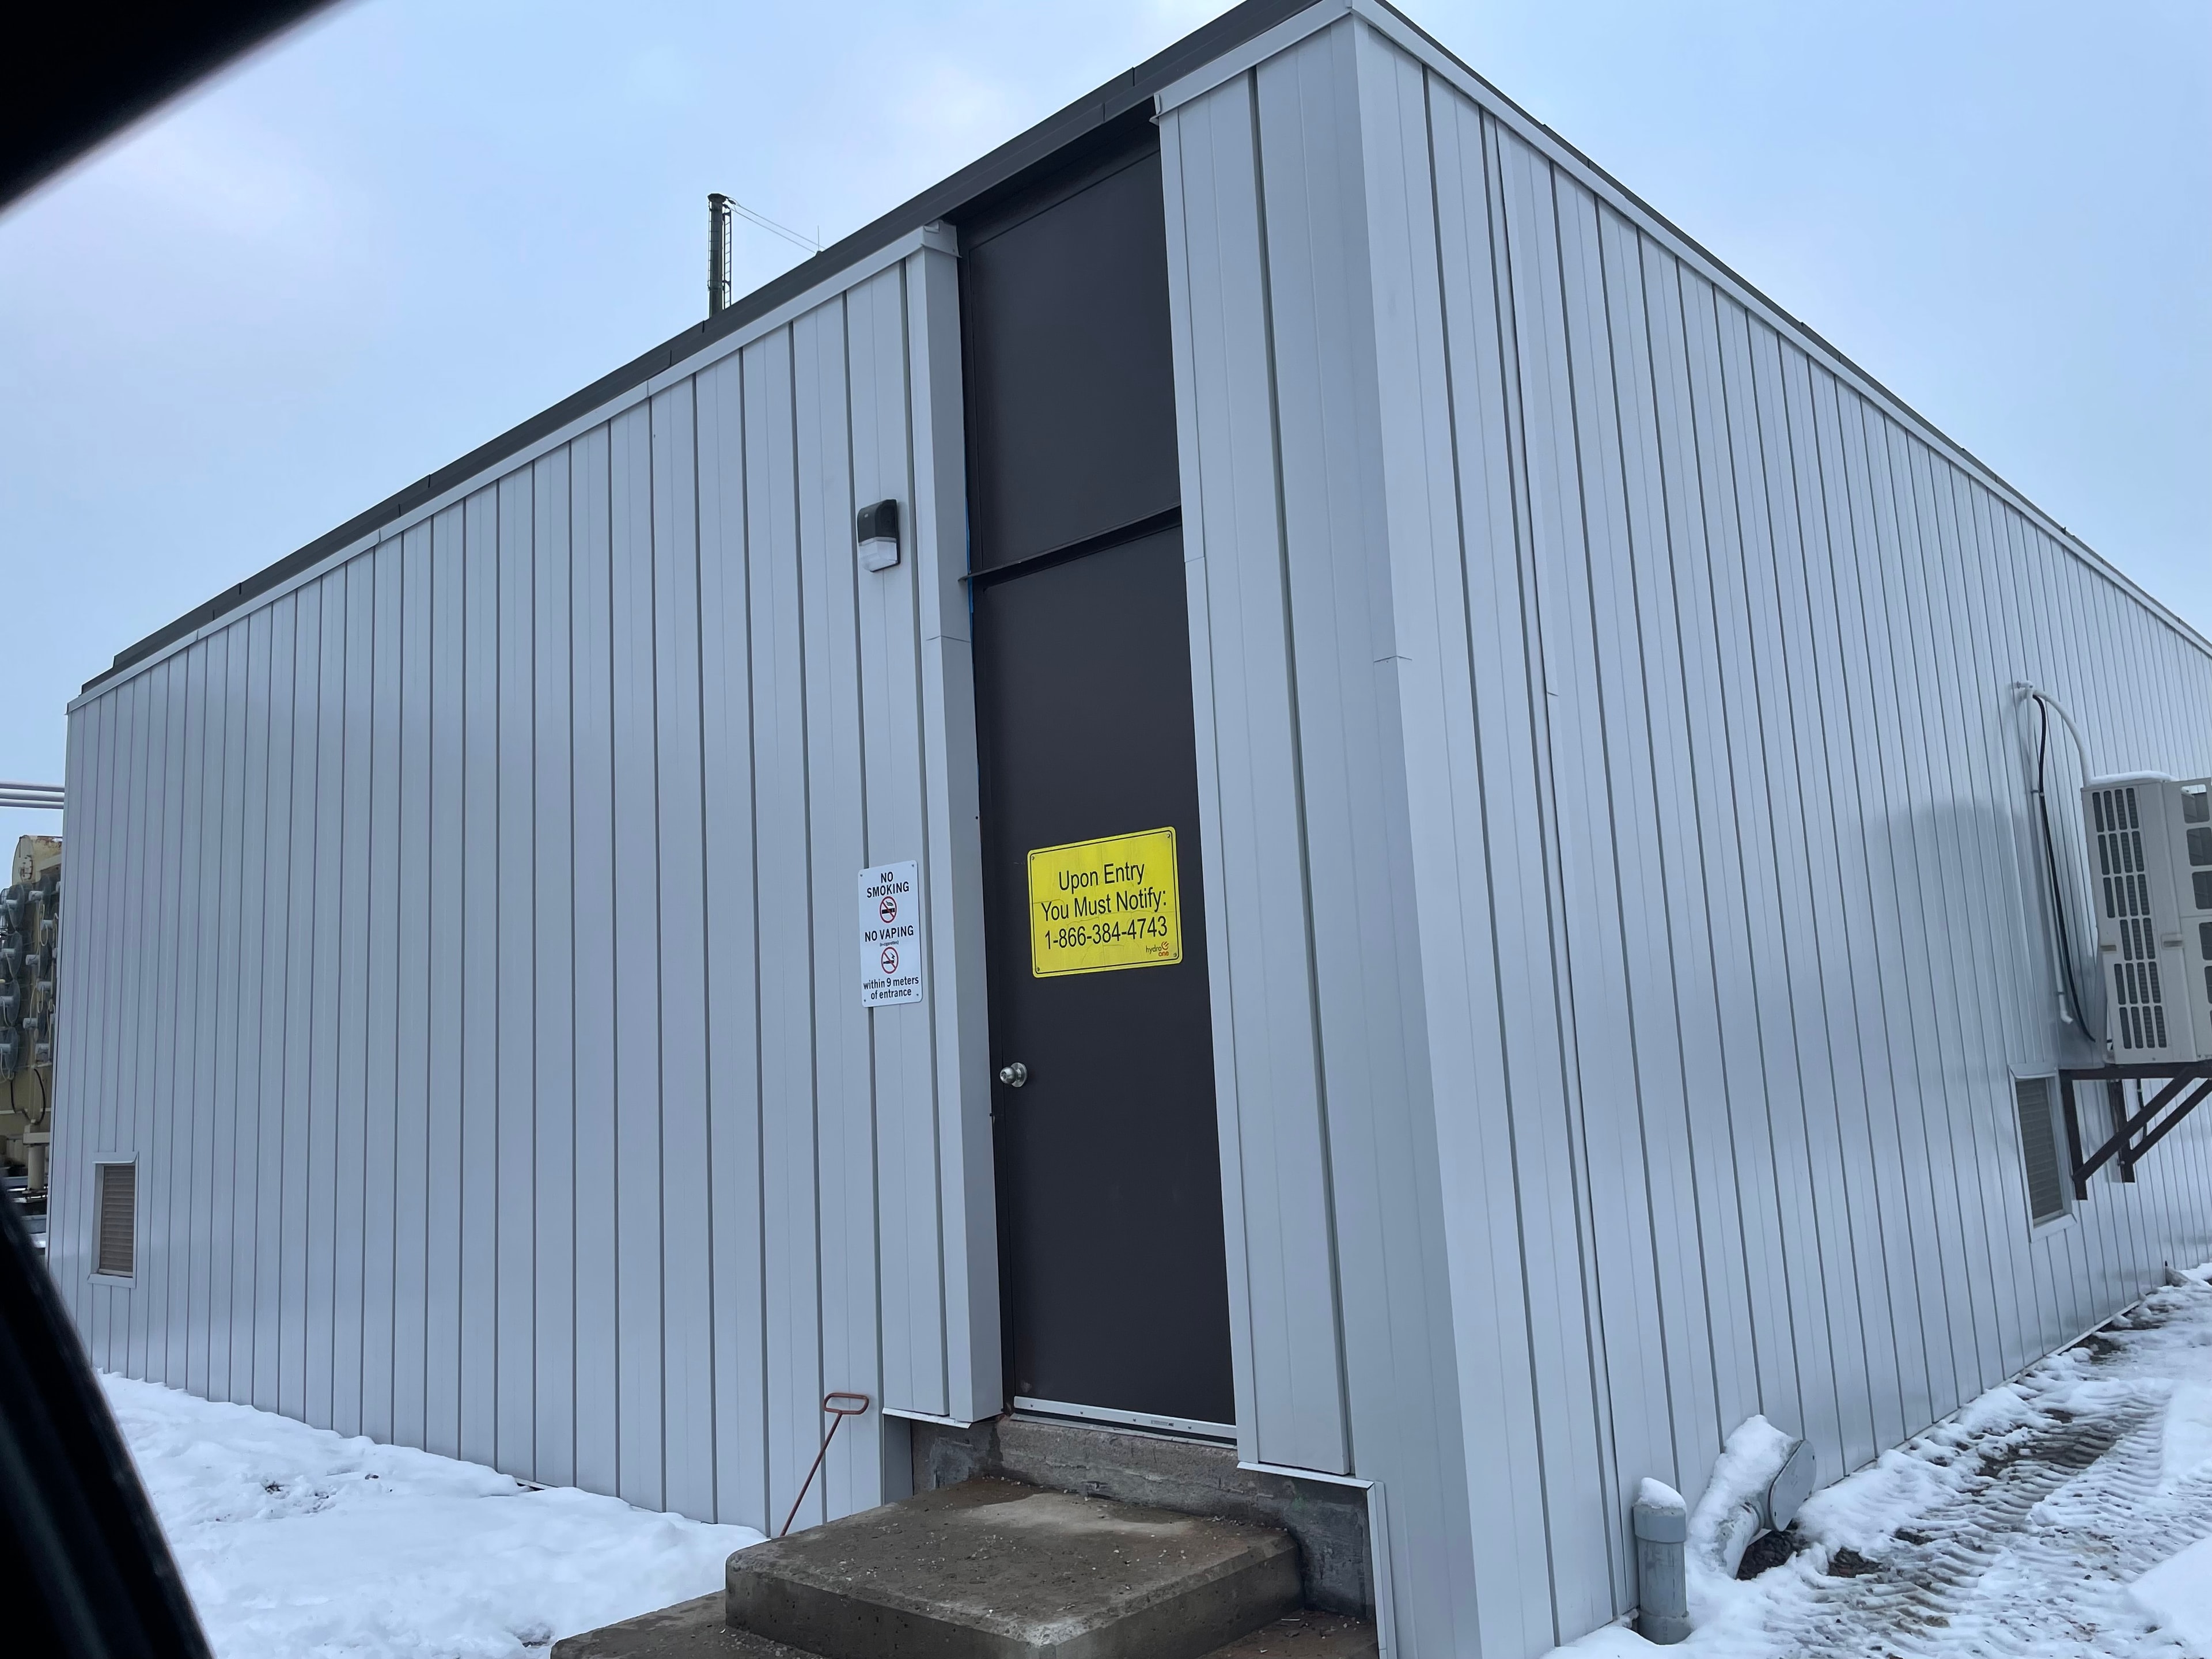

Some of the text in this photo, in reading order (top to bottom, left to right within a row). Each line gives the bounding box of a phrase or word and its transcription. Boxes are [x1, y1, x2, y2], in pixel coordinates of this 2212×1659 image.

[881, 872, 893, 883] NO
[1059, 862, 1145, 894] Upon Entry
[867, 881, 909, 898] SMOKING
[1041, 887, 1166, 922] You Must Notify:
[865, 925, 914, 942] NO VAPING
[1045, 916, 1167, 949] 1-866-384-4743
[1146, 945, 1162, 954] hydro
[863, 976, 919, 990] within 9 meters
[871, 988, 911, 999] of entrance
